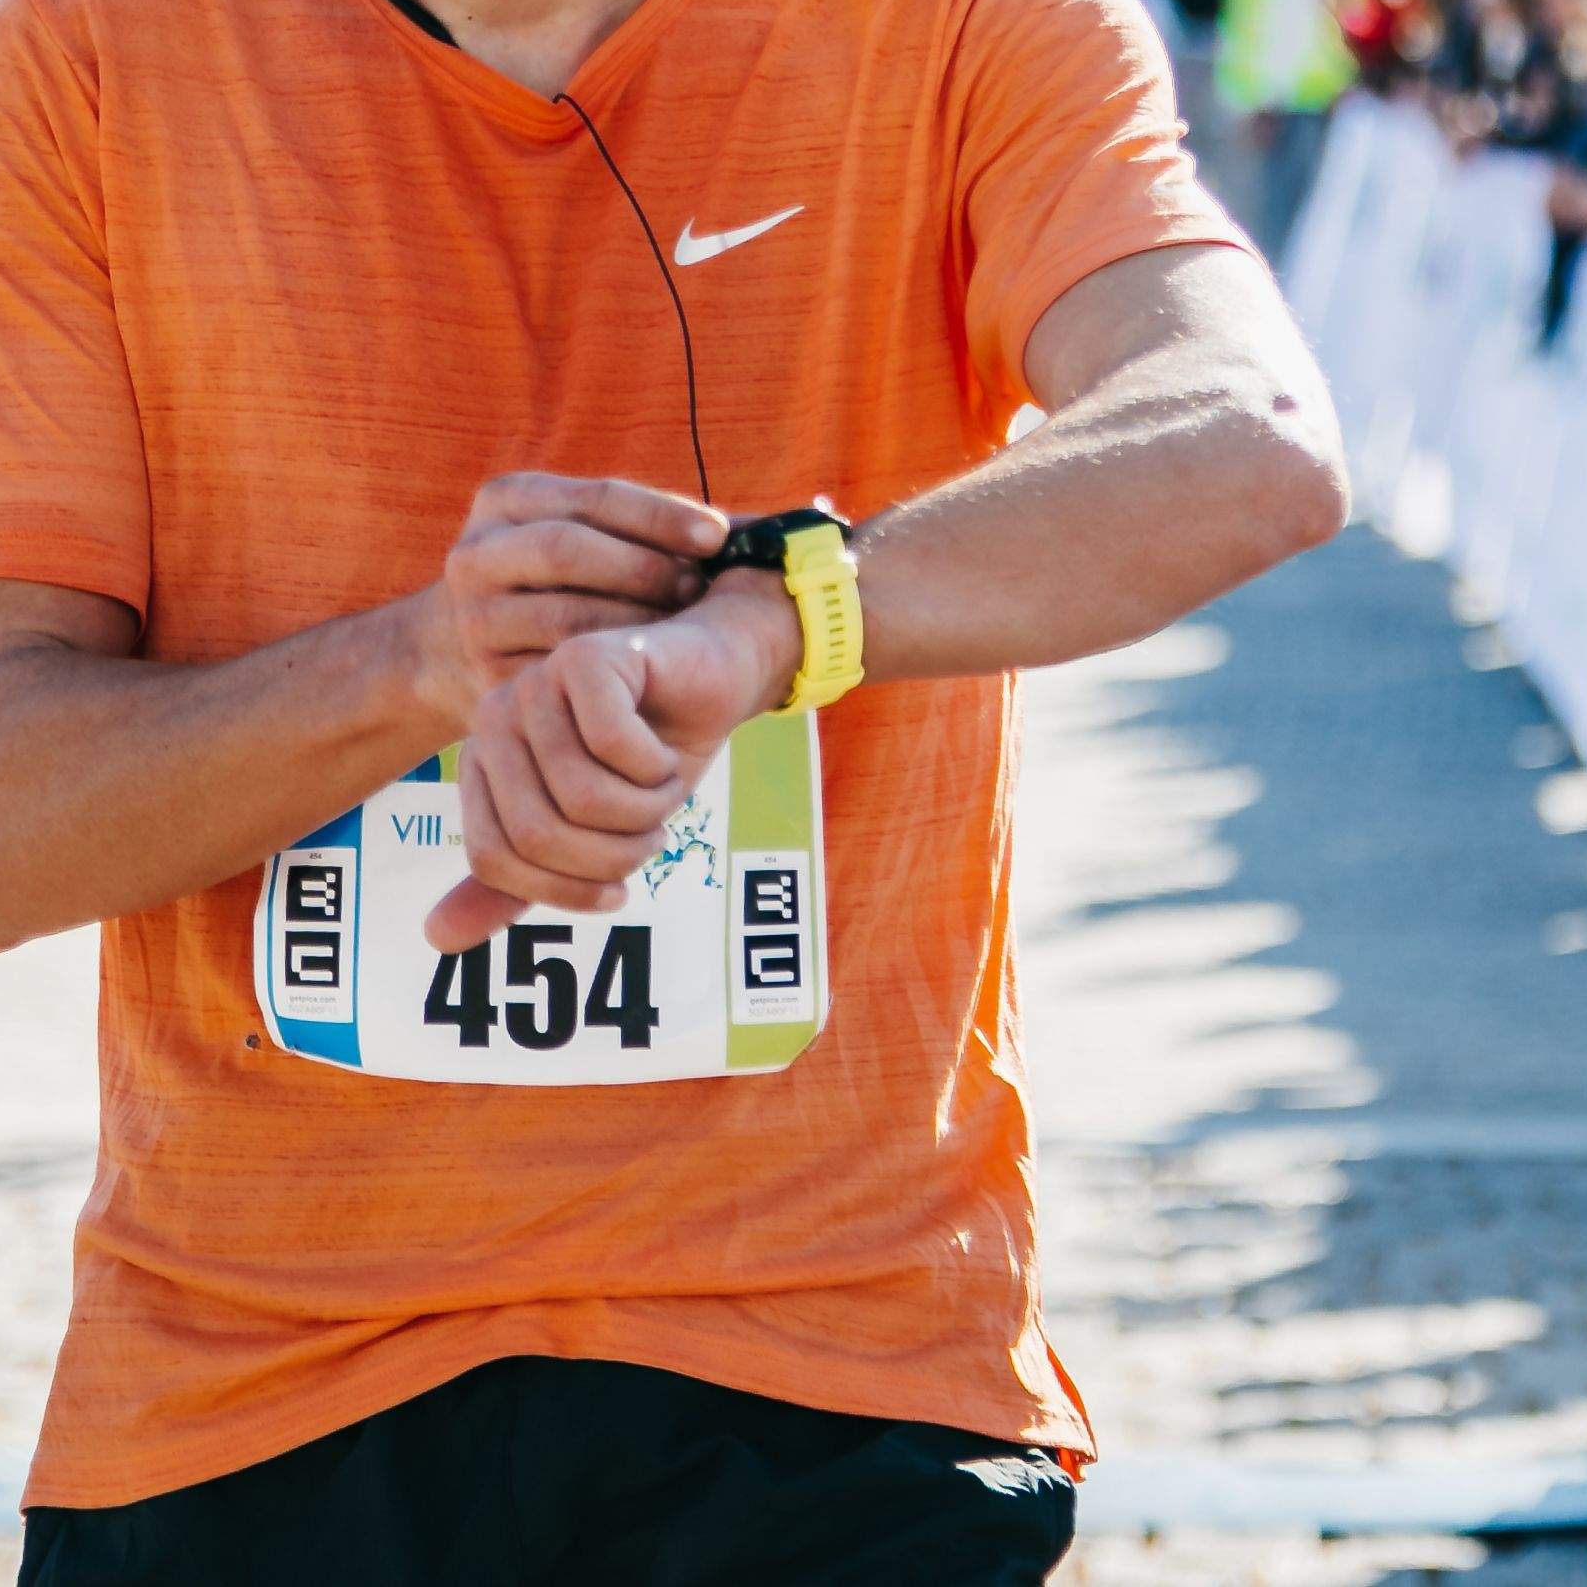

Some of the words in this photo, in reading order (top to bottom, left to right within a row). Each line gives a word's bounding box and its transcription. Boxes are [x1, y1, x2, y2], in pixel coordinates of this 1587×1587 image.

[391, 815, 442, 846] VIII
[309, 852, 323, 861] 454
[424, 923, 659, 1050] 454
